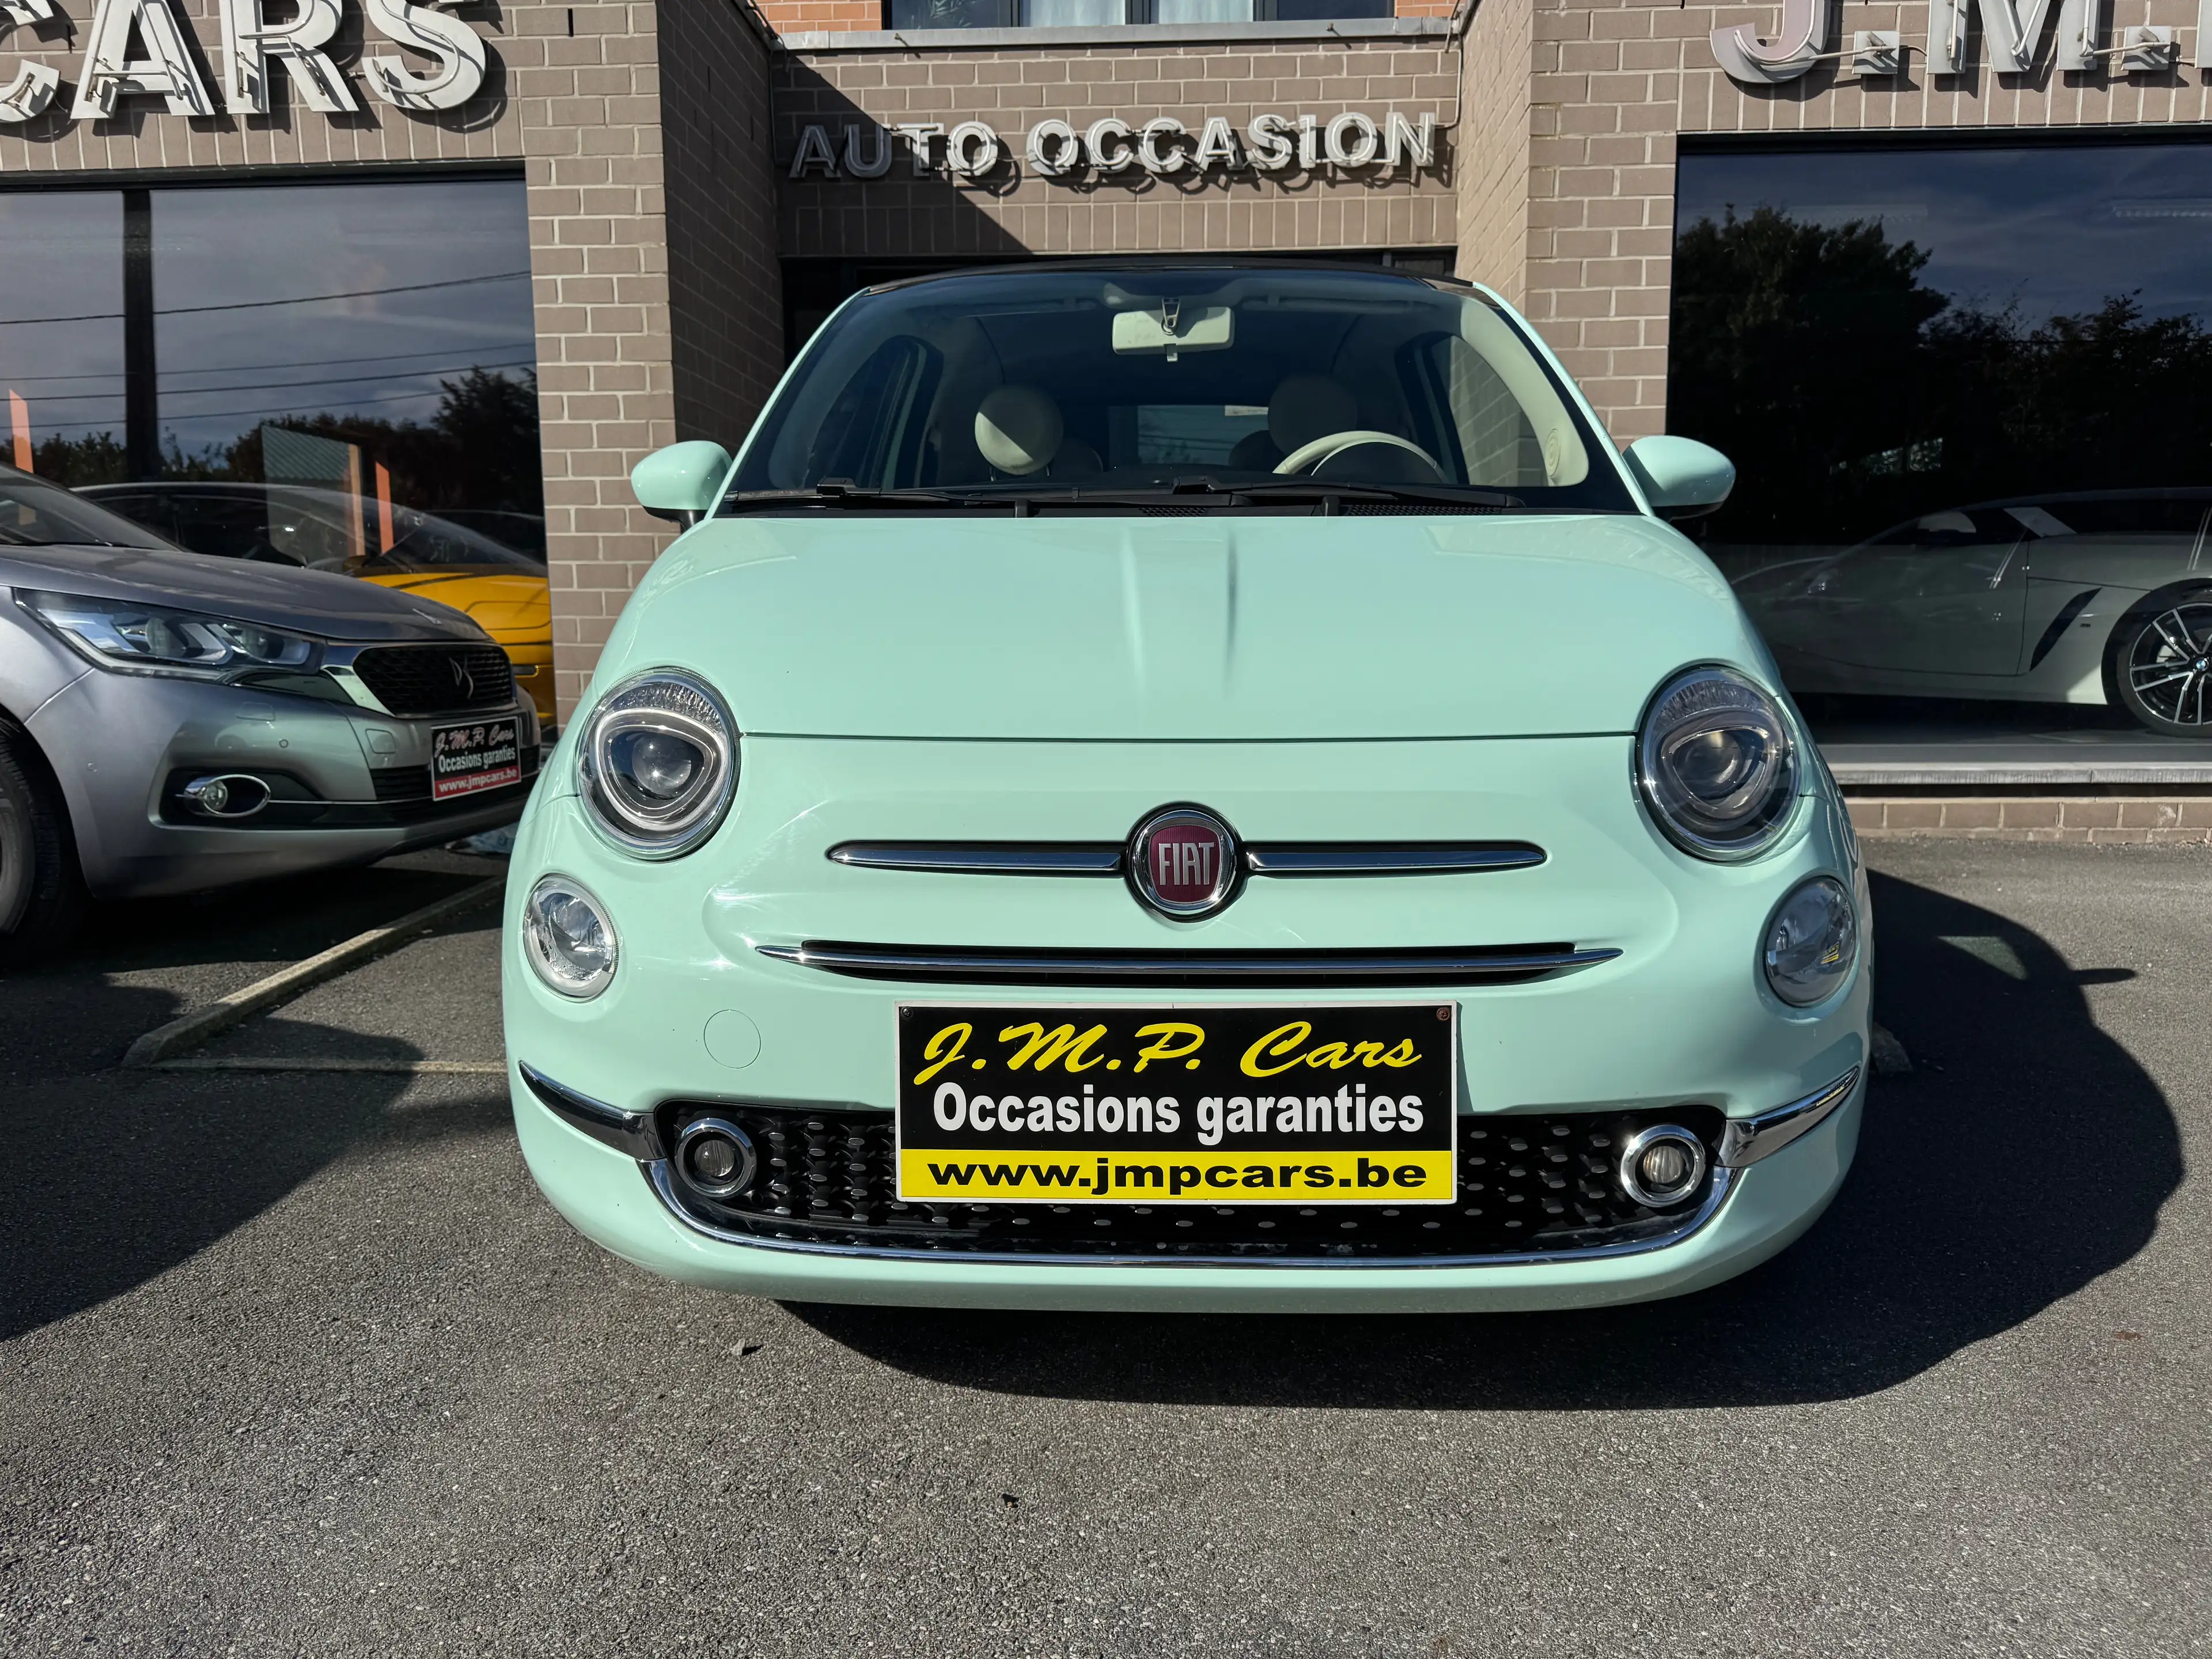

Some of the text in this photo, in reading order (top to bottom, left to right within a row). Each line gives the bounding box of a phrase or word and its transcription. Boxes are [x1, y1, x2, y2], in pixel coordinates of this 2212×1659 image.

[789, 112, 1435, 178] AUTO OCCASION
[488, 724, 515, 746] Cars
[438, 744, 516, 773] Occasions garanties
[438, 768, 517, 793] www.jmpcars.be
[1158, 842, 1215, 885] FIAT
[914, 1021, 1422, 1085] J.M.P. Cars
[933, 1082, 1423, 1146] Occasions garanties
[927, 1157, 1427, 1195] www.jmpcars.be
